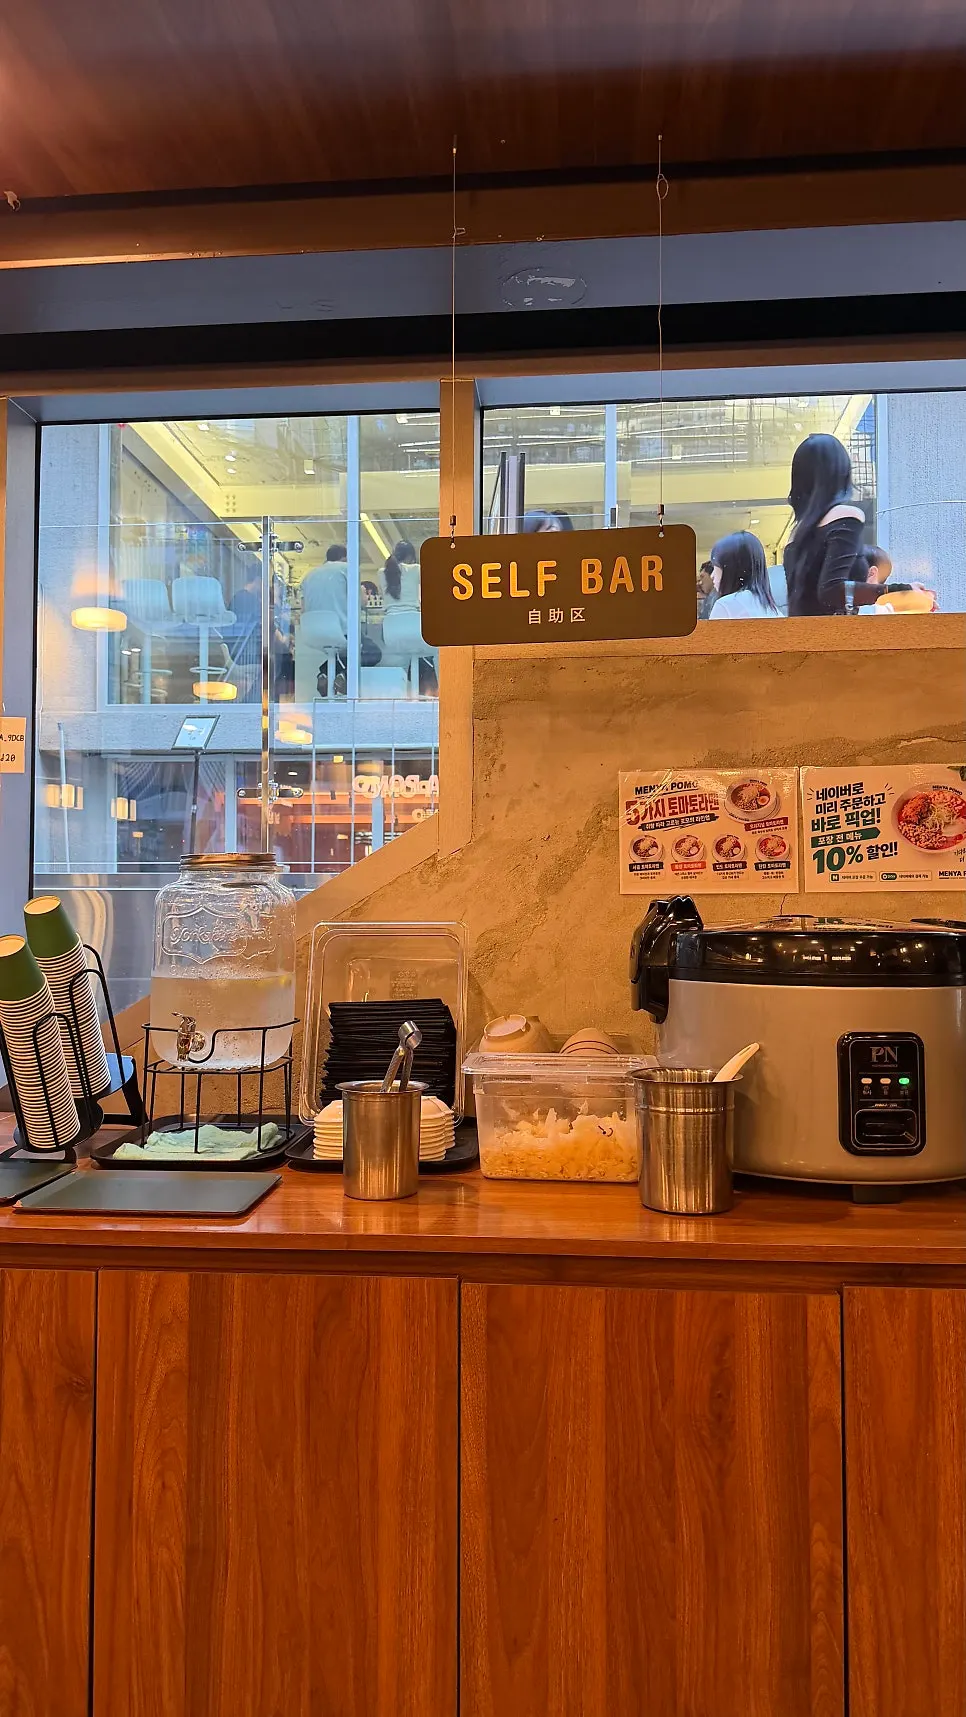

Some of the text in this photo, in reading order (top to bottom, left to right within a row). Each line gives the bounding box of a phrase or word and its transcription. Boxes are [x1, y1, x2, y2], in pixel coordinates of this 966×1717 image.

[452, 555, 663, 600] SELF BAR
[528, 607, 586, 624] 自助区
[635, 784, 669, 796] MENYA
[815, 781, 865, 801] 네이버로
[625, 793, 720, 826] 5가지 토마토라멘
[815, 793, 886, 814] 미리 주문하고
[811, 807, 881, 832] 바로 픽업!
[818, 831, 863, 845] 포장 전 메뉴
[812, 841, 898, 874] 10% 할인!
[869, 1046, 899, 1063] PN
